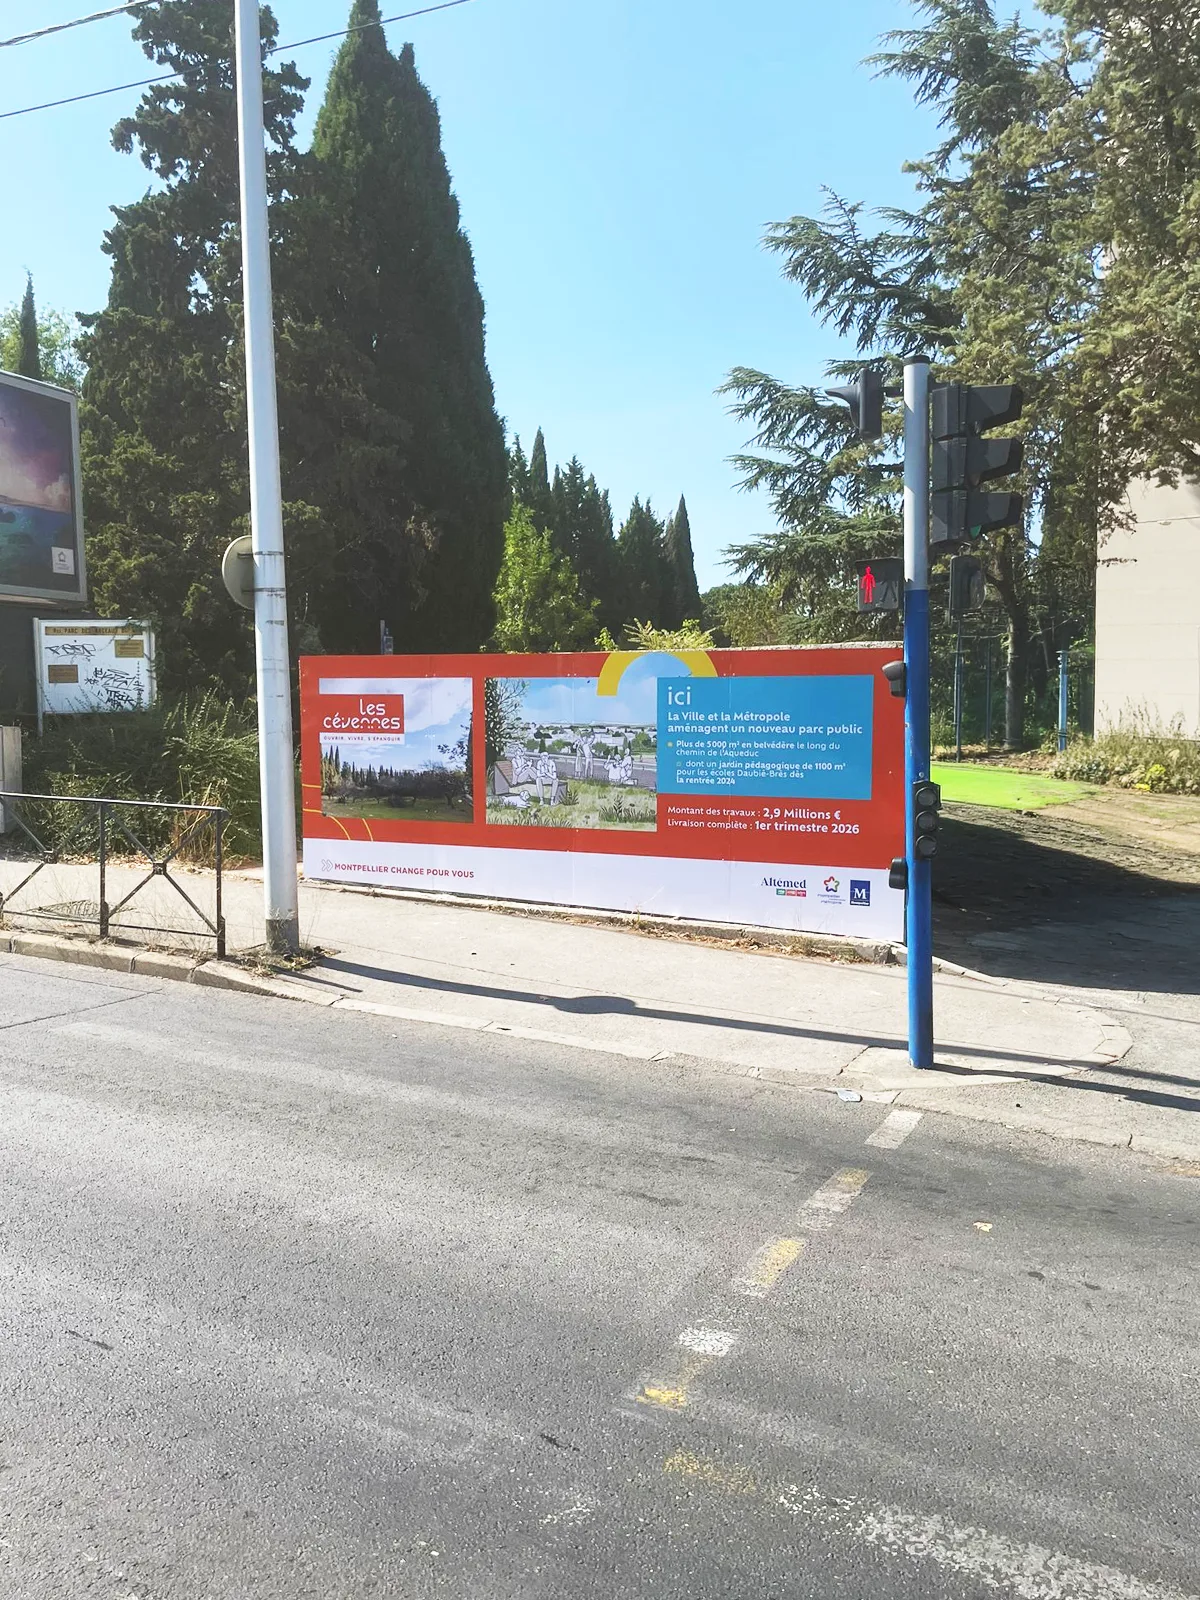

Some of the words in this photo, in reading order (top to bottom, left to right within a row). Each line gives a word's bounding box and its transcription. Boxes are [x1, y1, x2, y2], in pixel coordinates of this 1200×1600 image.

[667, 686, 692, 706] ici
[359, 698, 386, 716] les
[323, 712, 401, 730] cévennes
[667, 712, 680, 721] La
[681, 711, 705, 722] Ville
[707, 713, 719, 722] et
[720, 712, 731, 722] la
[733, 711, 791, 724] Métropole
[667, 723, 729, 734] aménagent
[731, 726, 745, 734] un
[748, 726, 796, 734] nouveau
[799, 726, 824, 735] parc
[826, 724, 863, 735] public
[676, 740, 693, 748] Plus
[694, 740, 705, 748] de
[706, 740, 727, 748] 5000
[753, 740, 795, 750] belvédère
[796, 741, 805, 750] le
[806, 741, 827, 752] long
[828, 742, 841, 750] du
[707, 749, 718, 757] de
[685, 760, 704, 768] dont
[718, 760, 743, 769] jardin
[744, 761, 801, 771] pédagogique
[802, 762, 813, 770] de
[814, 762, 833, 771] 1100
[676, 769, 696, 777] pour
[710, 769, 735, 777] écoles
[789, 770, 804, 778] dès
[676, 775, 684, 783] la
[716, 776, 736, 785] 2024
[667, 806, 704, 815] Montant
[705, 807, 721, 816] des
[723, 808, 756, 817] travaux
[763, 807, 781, 818] 2,9
[784, 808, 831, 820] Millions
[833, 810, 841, 820] €
[667, 819, 704, 828] Livraison
[706, 821, 748, 830] complète
[755, 821, 772, 831] 1er
[774, 821, 829, 834] trimestre
[831, 823, 860, 834] 2026
[334, 863, 389, 873] MONTPELLIER
[390, 866, 424, 875] CHANGE
[426, 868, 450, 877] POUR
[452, 870, 475, 878] VOUS
[854, 888, 867, 899] M
